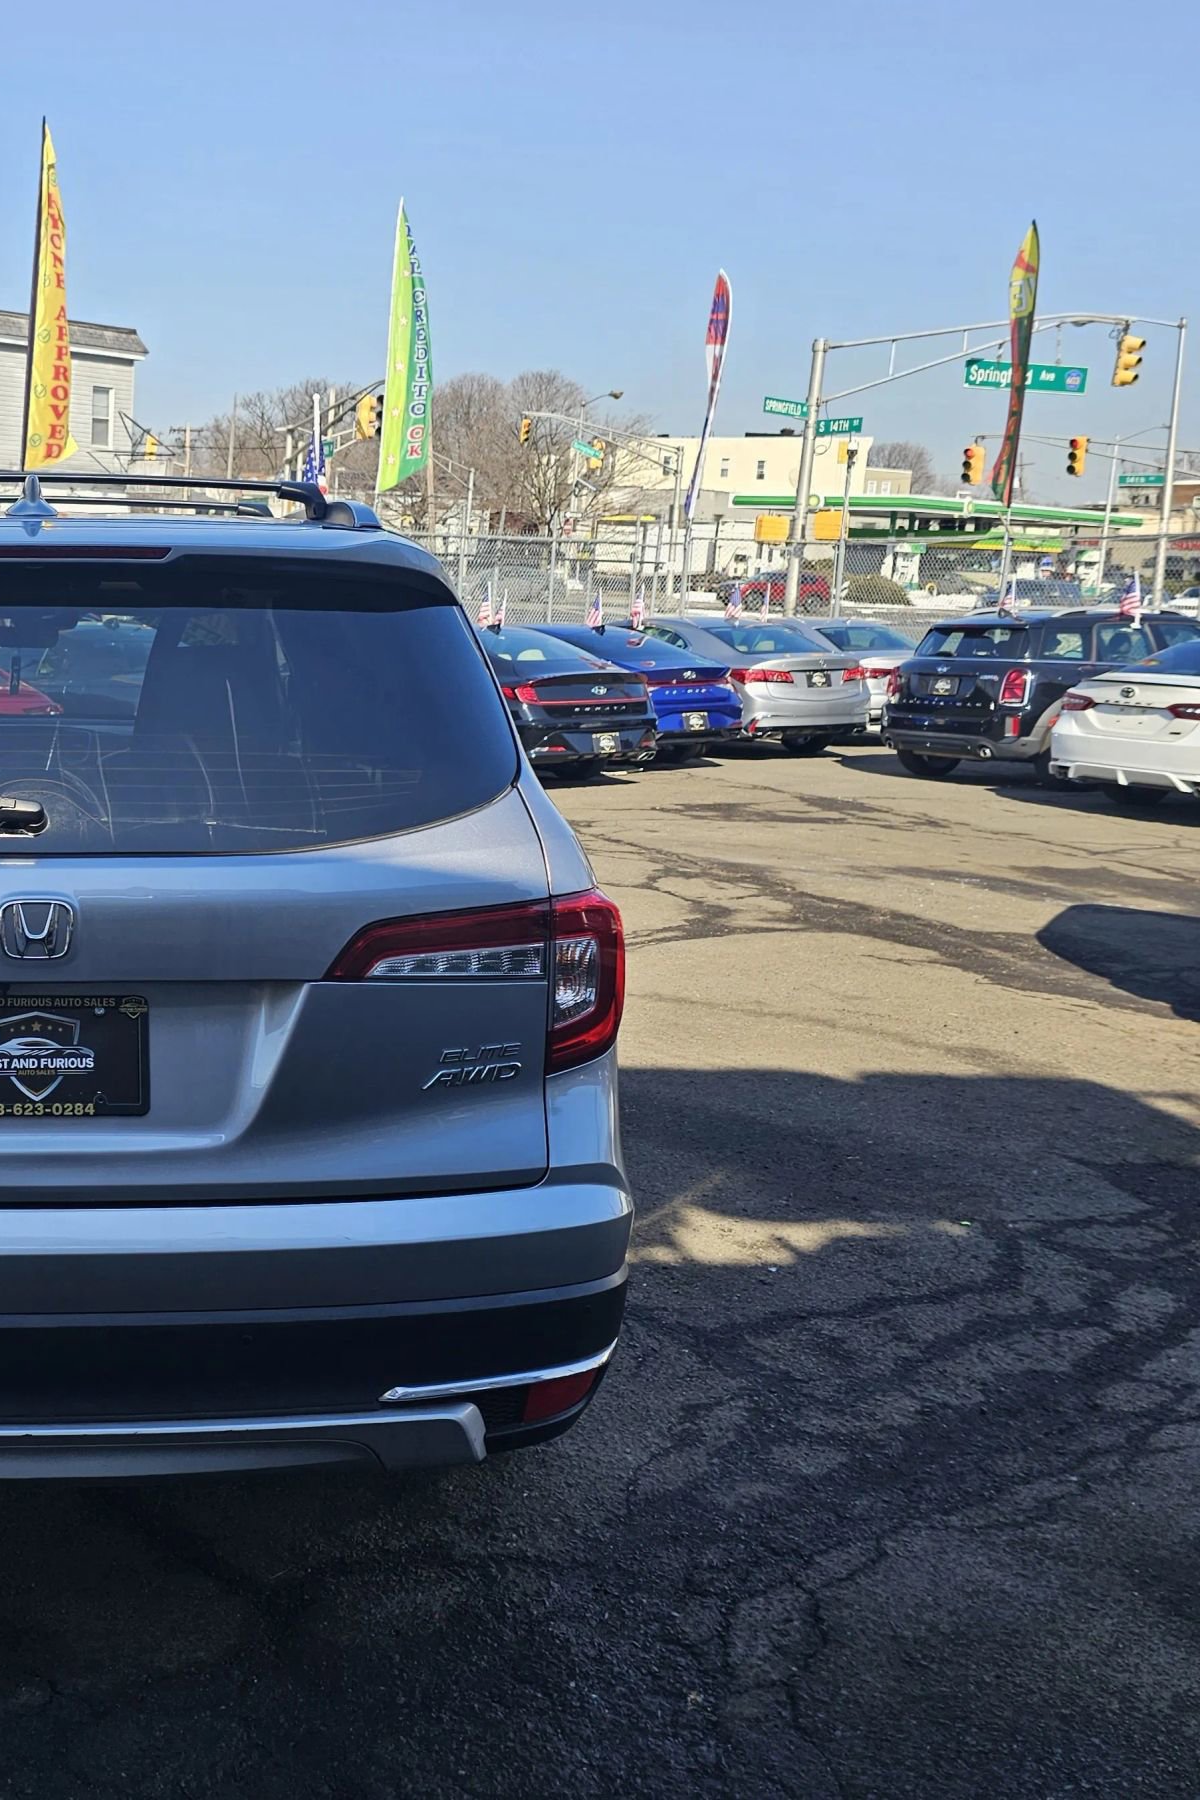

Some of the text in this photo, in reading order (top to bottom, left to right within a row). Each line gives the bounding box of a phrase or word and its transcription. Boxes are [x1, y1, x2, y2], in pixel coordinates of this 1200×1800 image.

[764, 398, 802, 416] SPRINGFIELD
[818, 421, 826, 433] S
[830, 420, 849, 432] 14TH
[407, 425, 425, 459] OK
[7, 997, 51, 1008] FURIOUS
[52, 997, 82, 1007] AUTO
[83, 997, 116, 1008] SALES
[439, 1042, 522, 1064] ELITE
[11, 1058, 38, 1068] AND
[40, 1057, 95, 1068] FURIOUS
